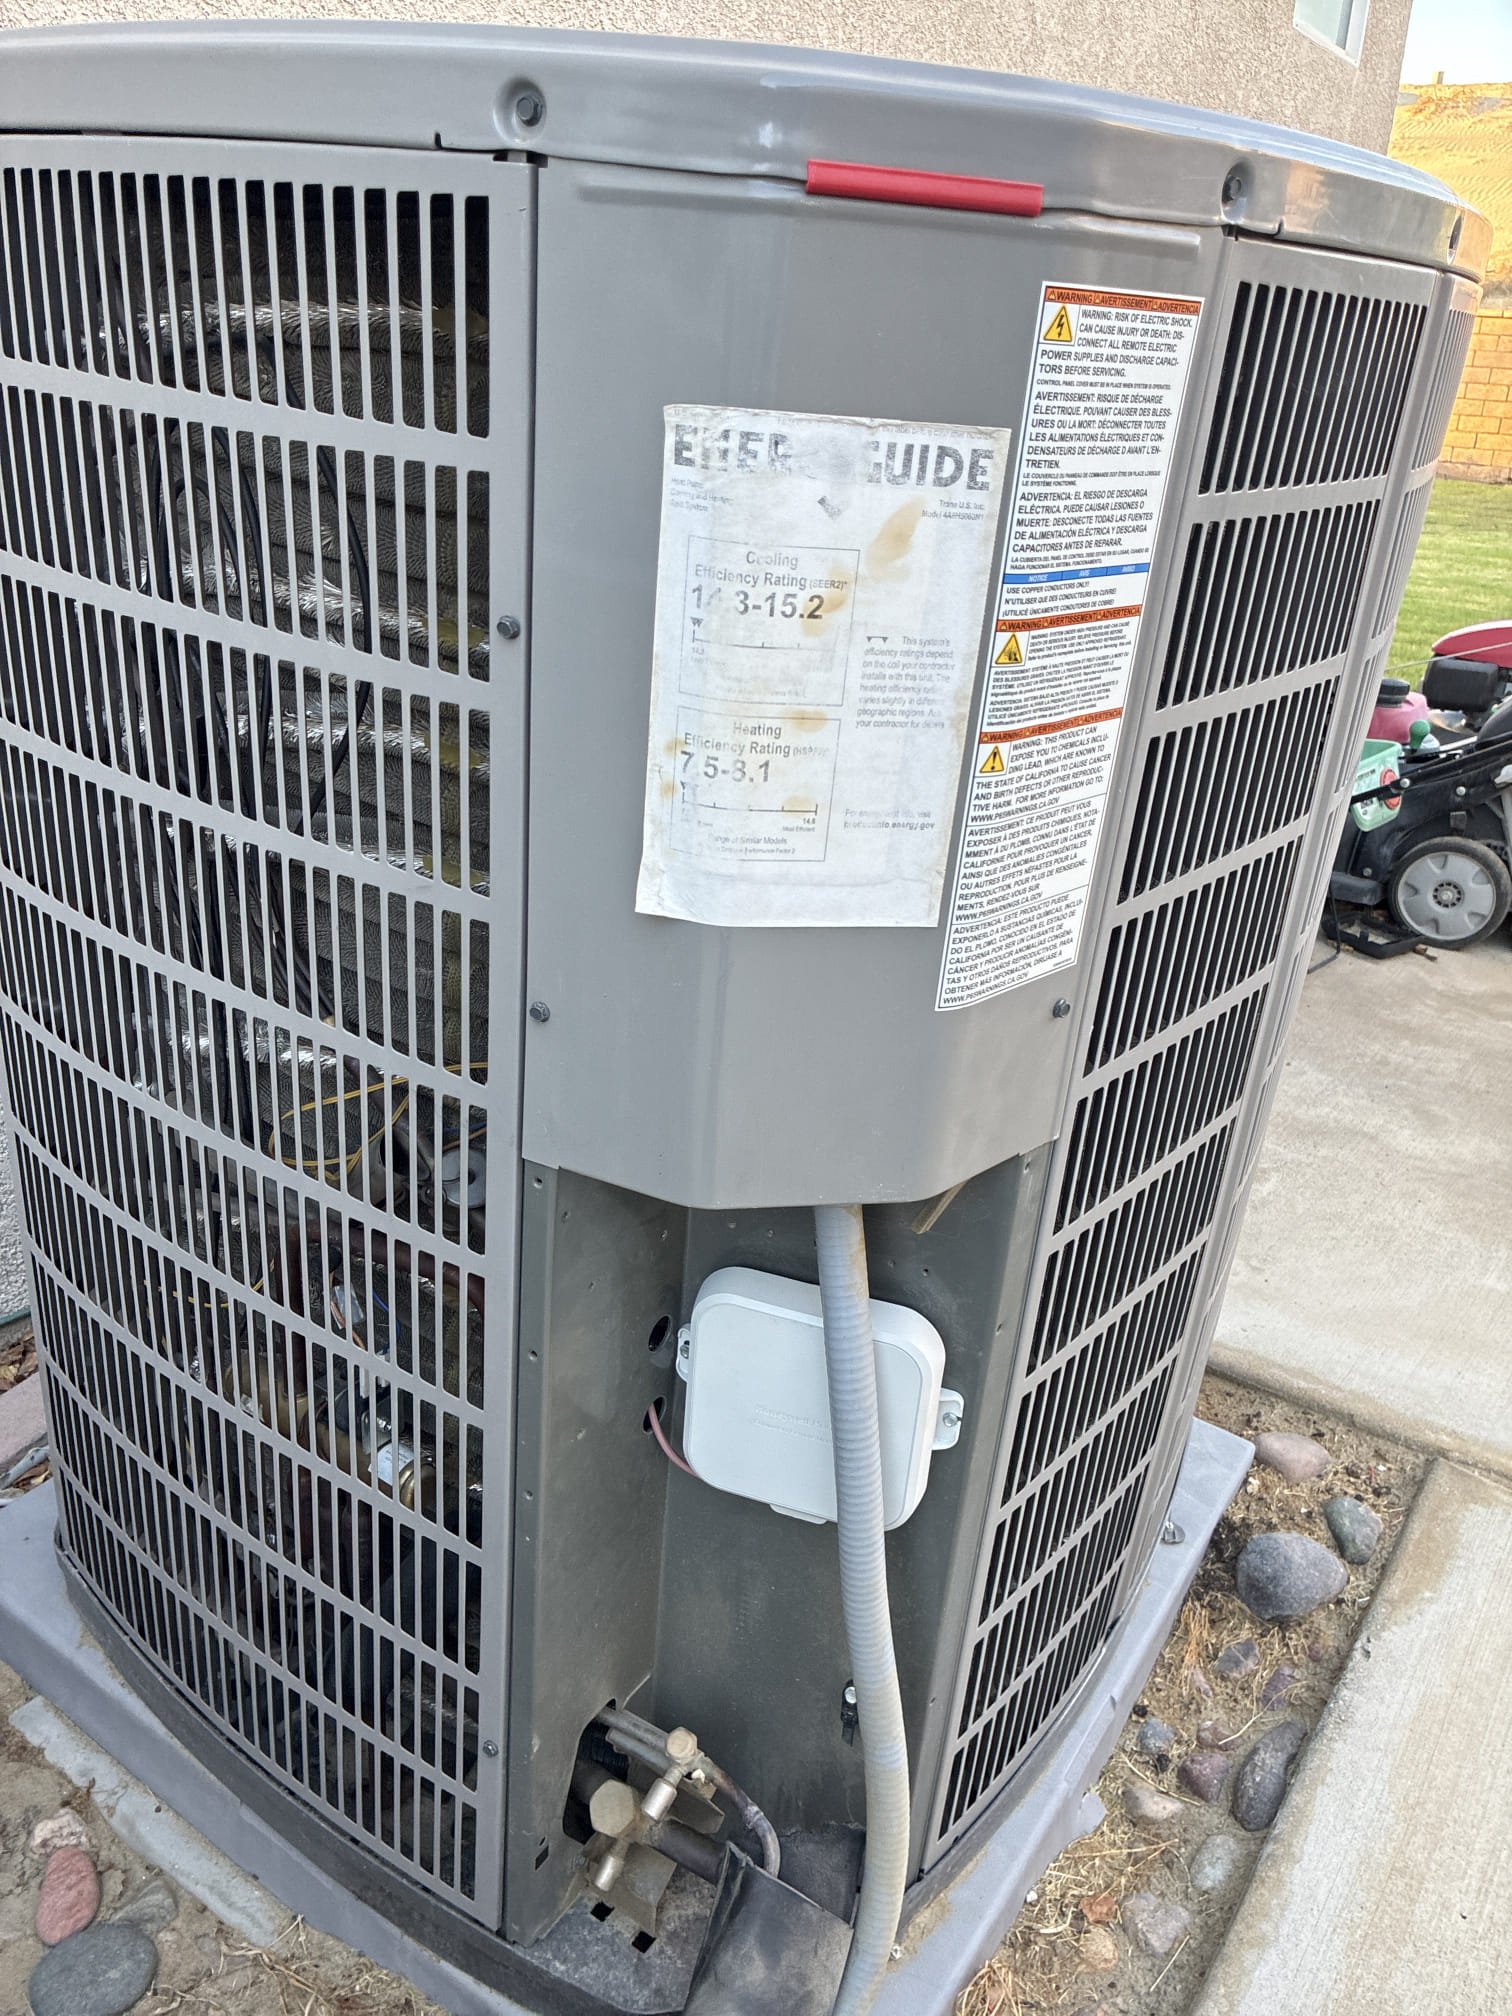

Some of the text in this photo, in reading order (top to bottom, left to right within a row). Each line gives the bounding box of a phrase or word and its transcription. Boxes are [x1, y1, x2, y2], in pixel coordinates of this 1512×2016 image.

[1056, 291, 1199, 313] WARNING AVERTISSEMENT ADVERTENCIA
[1081, 309, 1192, 327] WARNING: RISK OF ELECTRIC SHOCK.
[1079, 322, 1093, 333] CAN
[1093, 323, 1116, 335] CAUSE
[1116, 325, 1139, 336] INJURY
[1139, 327, 1149, 337] OR
[1076, 336, 1177, 352] CONNECT ALL REMOTE ELECTRIC
[1040, 349, 1072, 360] POWER
[1073, 351, 1104, 362] SUPPLIES
[1104, 353, 1118, 363] AND
[1118, 354, 1154, 365] DISCHARGE
[1038, 363, 1125, 377] TORS BEFORE SERVICING.
[1096, 393, 1120, 403] RISQUE
[1120, 393, 1129, 403] DE
[1012, 537, 1122, 552] CAPACITORES ANTES DE REPARAR.
[695, 564, 760, 588] Efficiency
[763, 572, 808, 590] Rating
[1007, 620, 1041, 630] WARNING
[1048, 612, 1097, 626] AVERTISSEMENT
[733, 721, 782, 739] Heating
[989, 731, 1023, 741] WARNING
[684, 732, 746, 756] Efficiency
[749, 741, 791, 758] Rating
